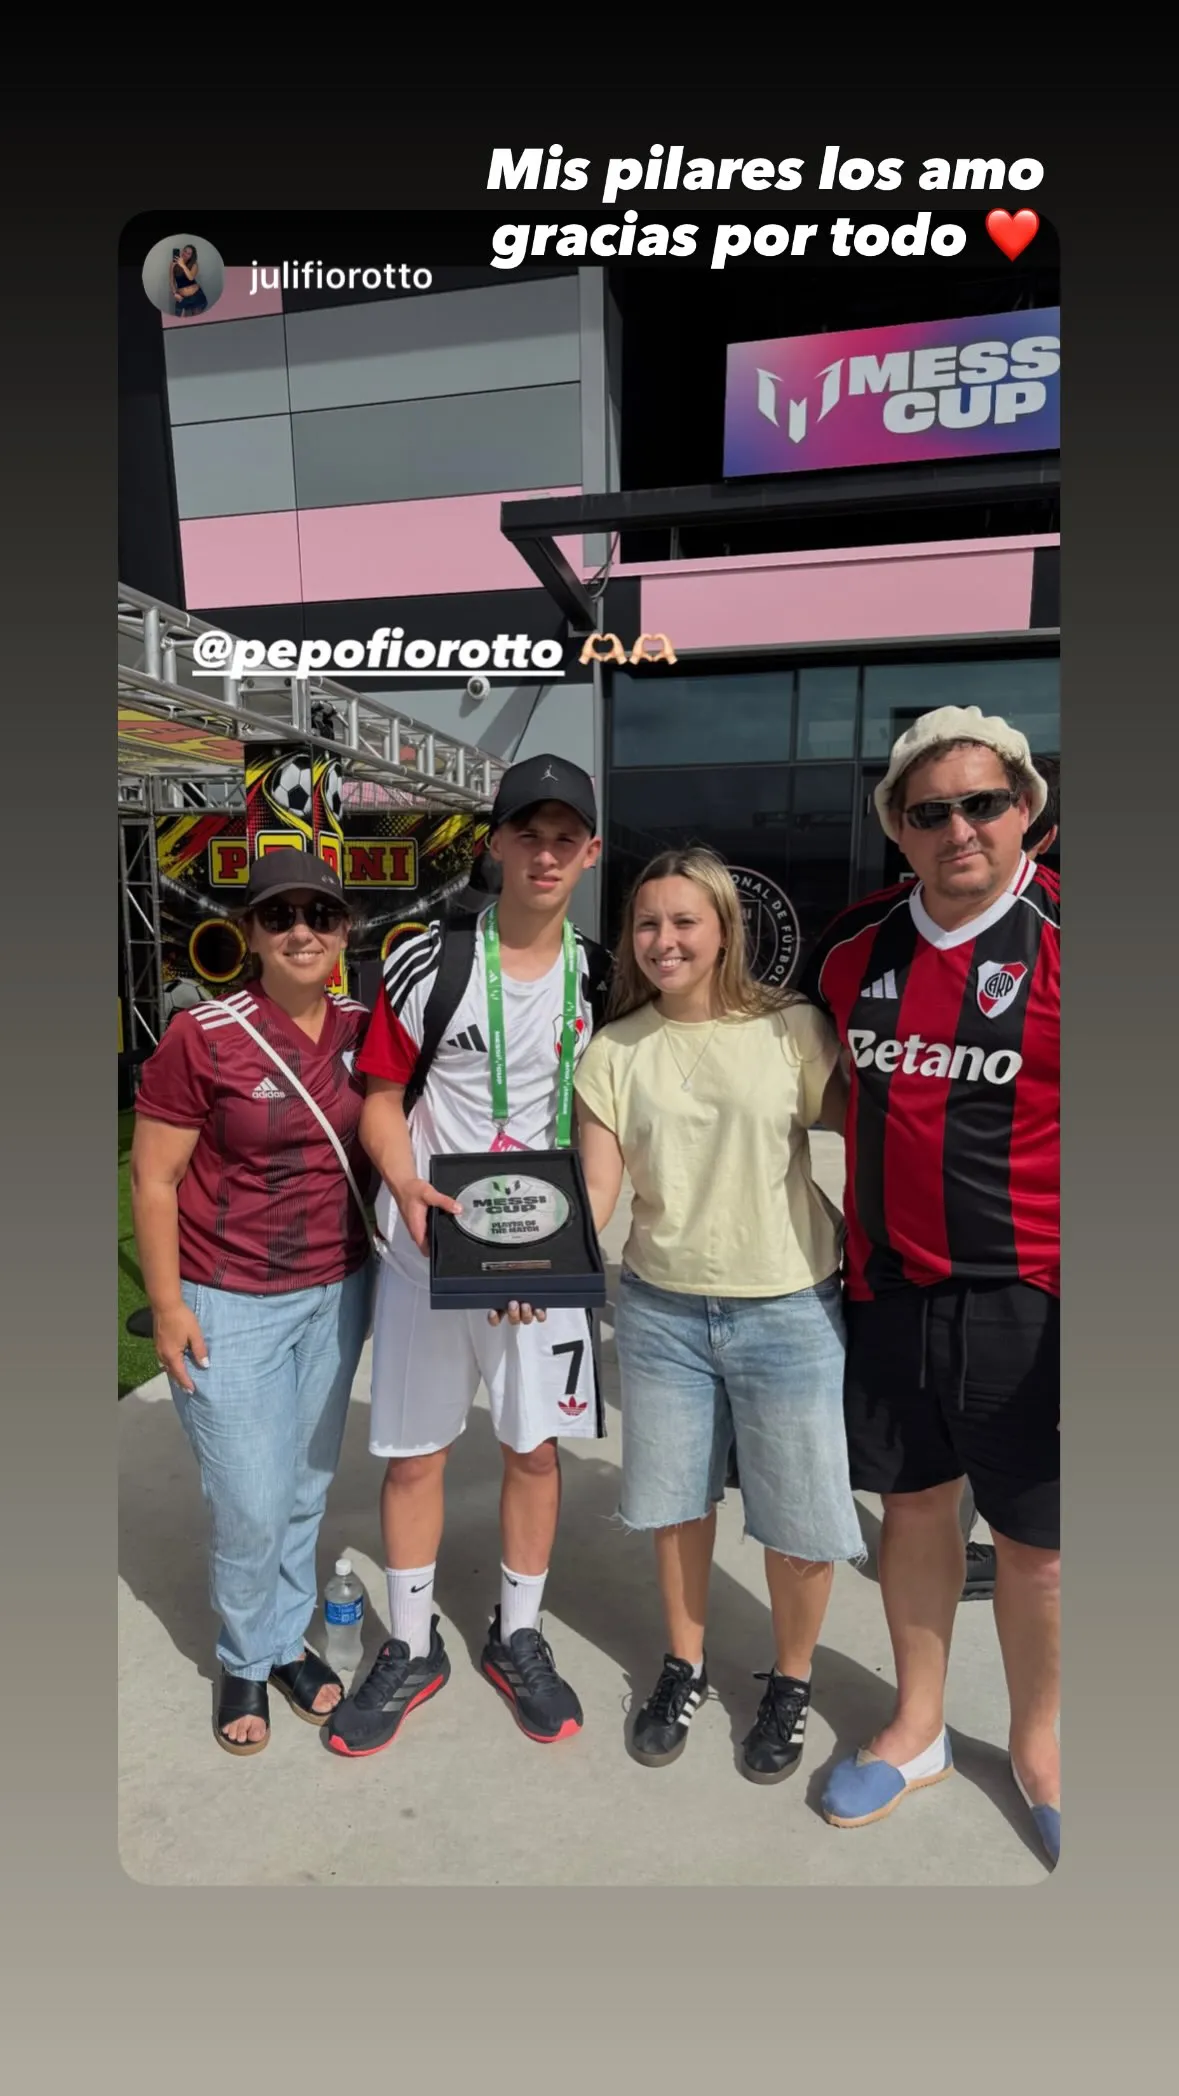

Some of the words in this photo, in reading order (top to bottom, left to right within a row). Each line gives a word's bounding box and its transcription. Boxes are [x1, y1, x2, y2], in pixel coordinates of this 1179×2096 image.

[883, 381, 1046, 434] CUP
[771, 900, 788, 920] DE
[847, 1029, 1023, 1085] Betano
[252, 1090, 286, 1099] adidas
[472, 1196, 547, 1208] MESSI
[485, 1204, 537, 1214] CUP
[552, 1340, 584, 1395] 7
